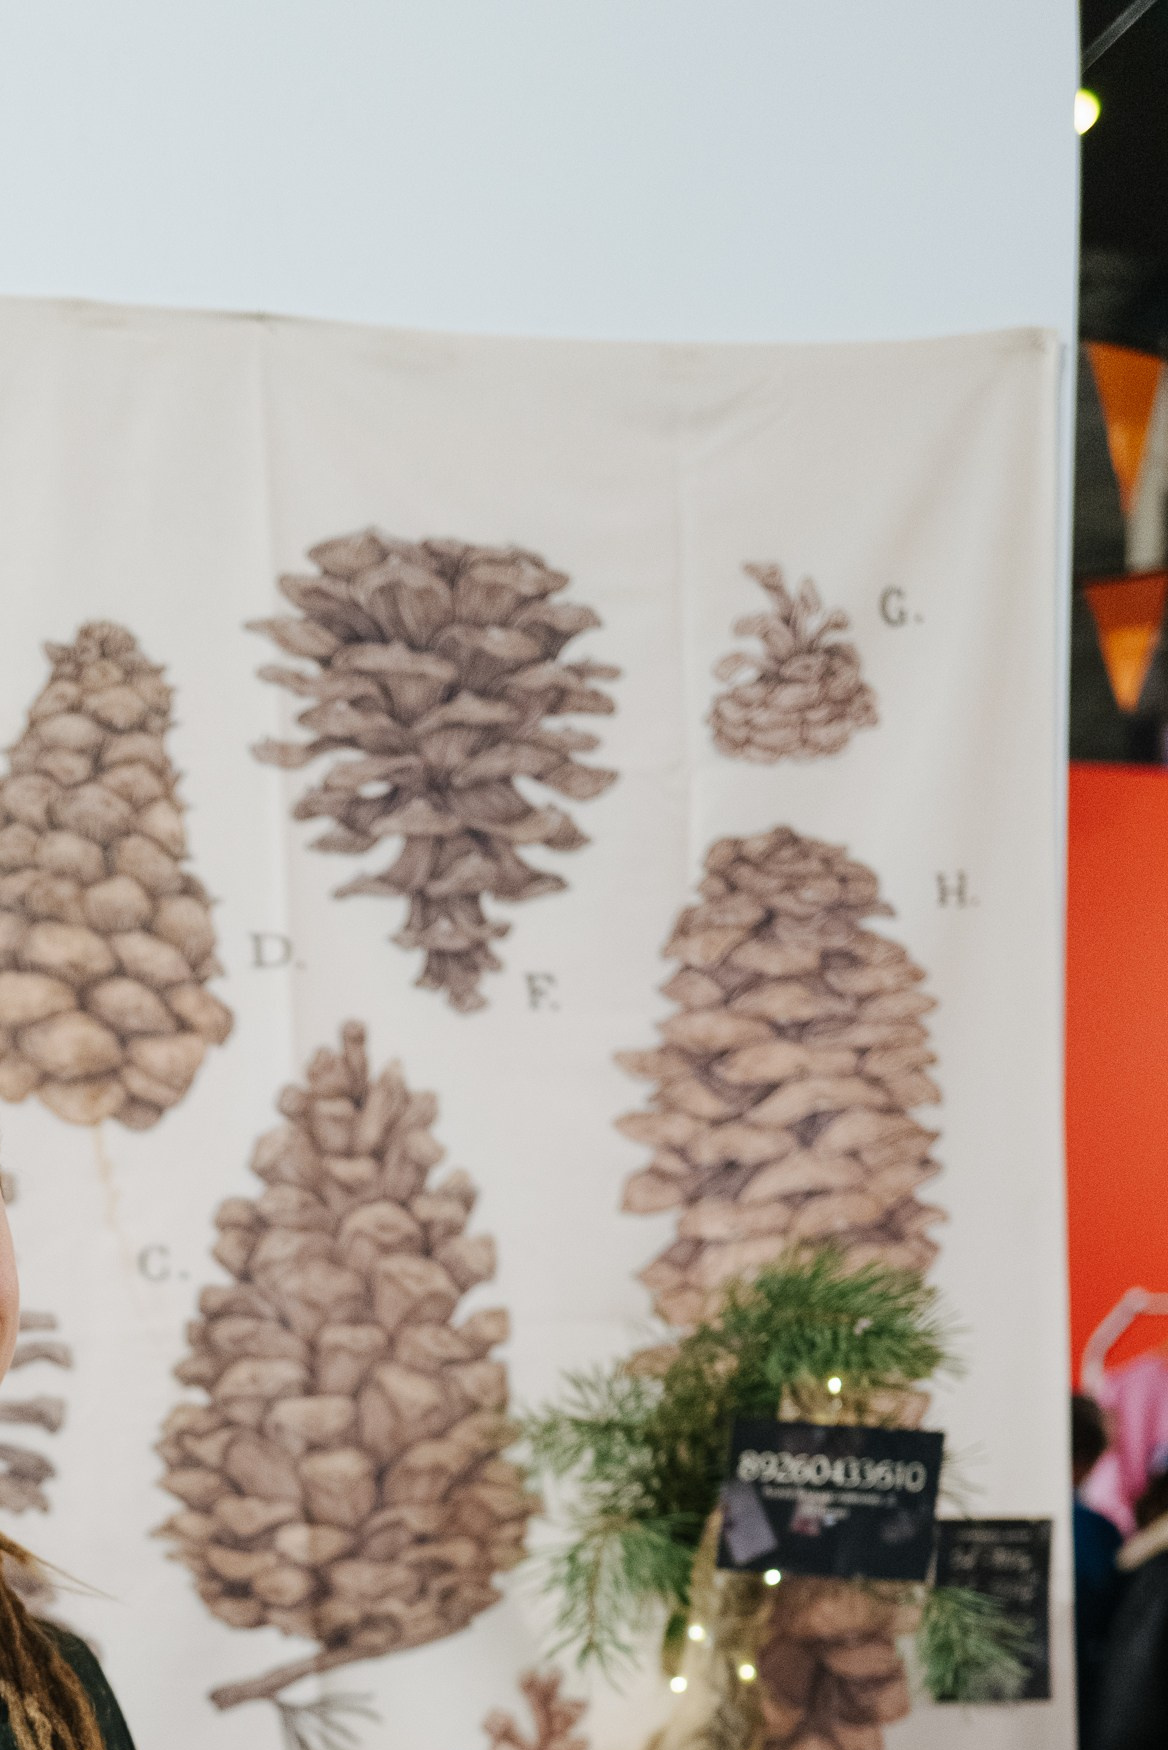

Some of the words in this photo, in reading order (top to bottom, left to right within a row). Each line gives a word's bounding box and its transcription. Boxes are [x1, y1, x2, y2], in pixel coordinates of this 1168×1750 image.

[879, 588, 923, 625] G.
[935, 872, 979, 908] H.
[251, 933, 305, 968] D.
[525, 973, 560, 1009] F.
[136, 1245, 189, 1281] C.
